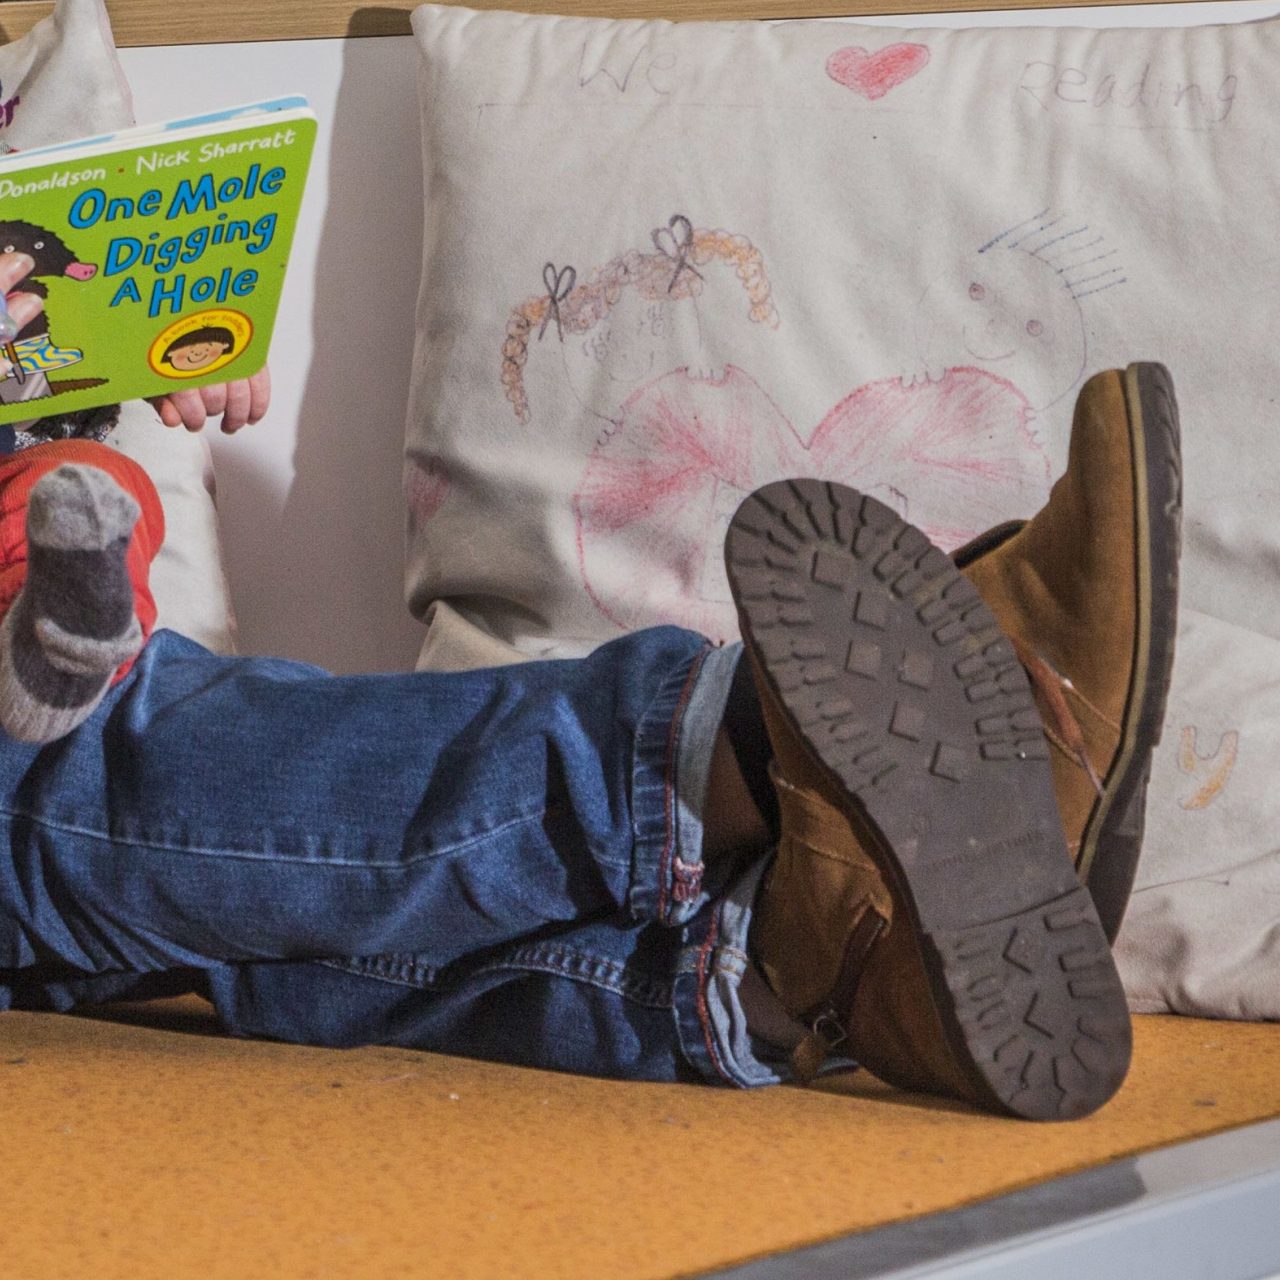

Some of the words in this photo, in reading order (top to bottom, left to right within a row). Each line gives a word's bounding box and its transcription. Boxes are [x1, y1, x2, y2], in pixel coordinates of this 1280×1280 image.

[136, 150, 191, 177] Nick
[198, 129, 297, 163] Sharratt
[68, 184, 162, 230] One
[166, 163, 287, 221] Mole
[103, 212, 278, 278] Digging
[109, 277, 142, 308] A
[148, 266, 259, 319] Hole
